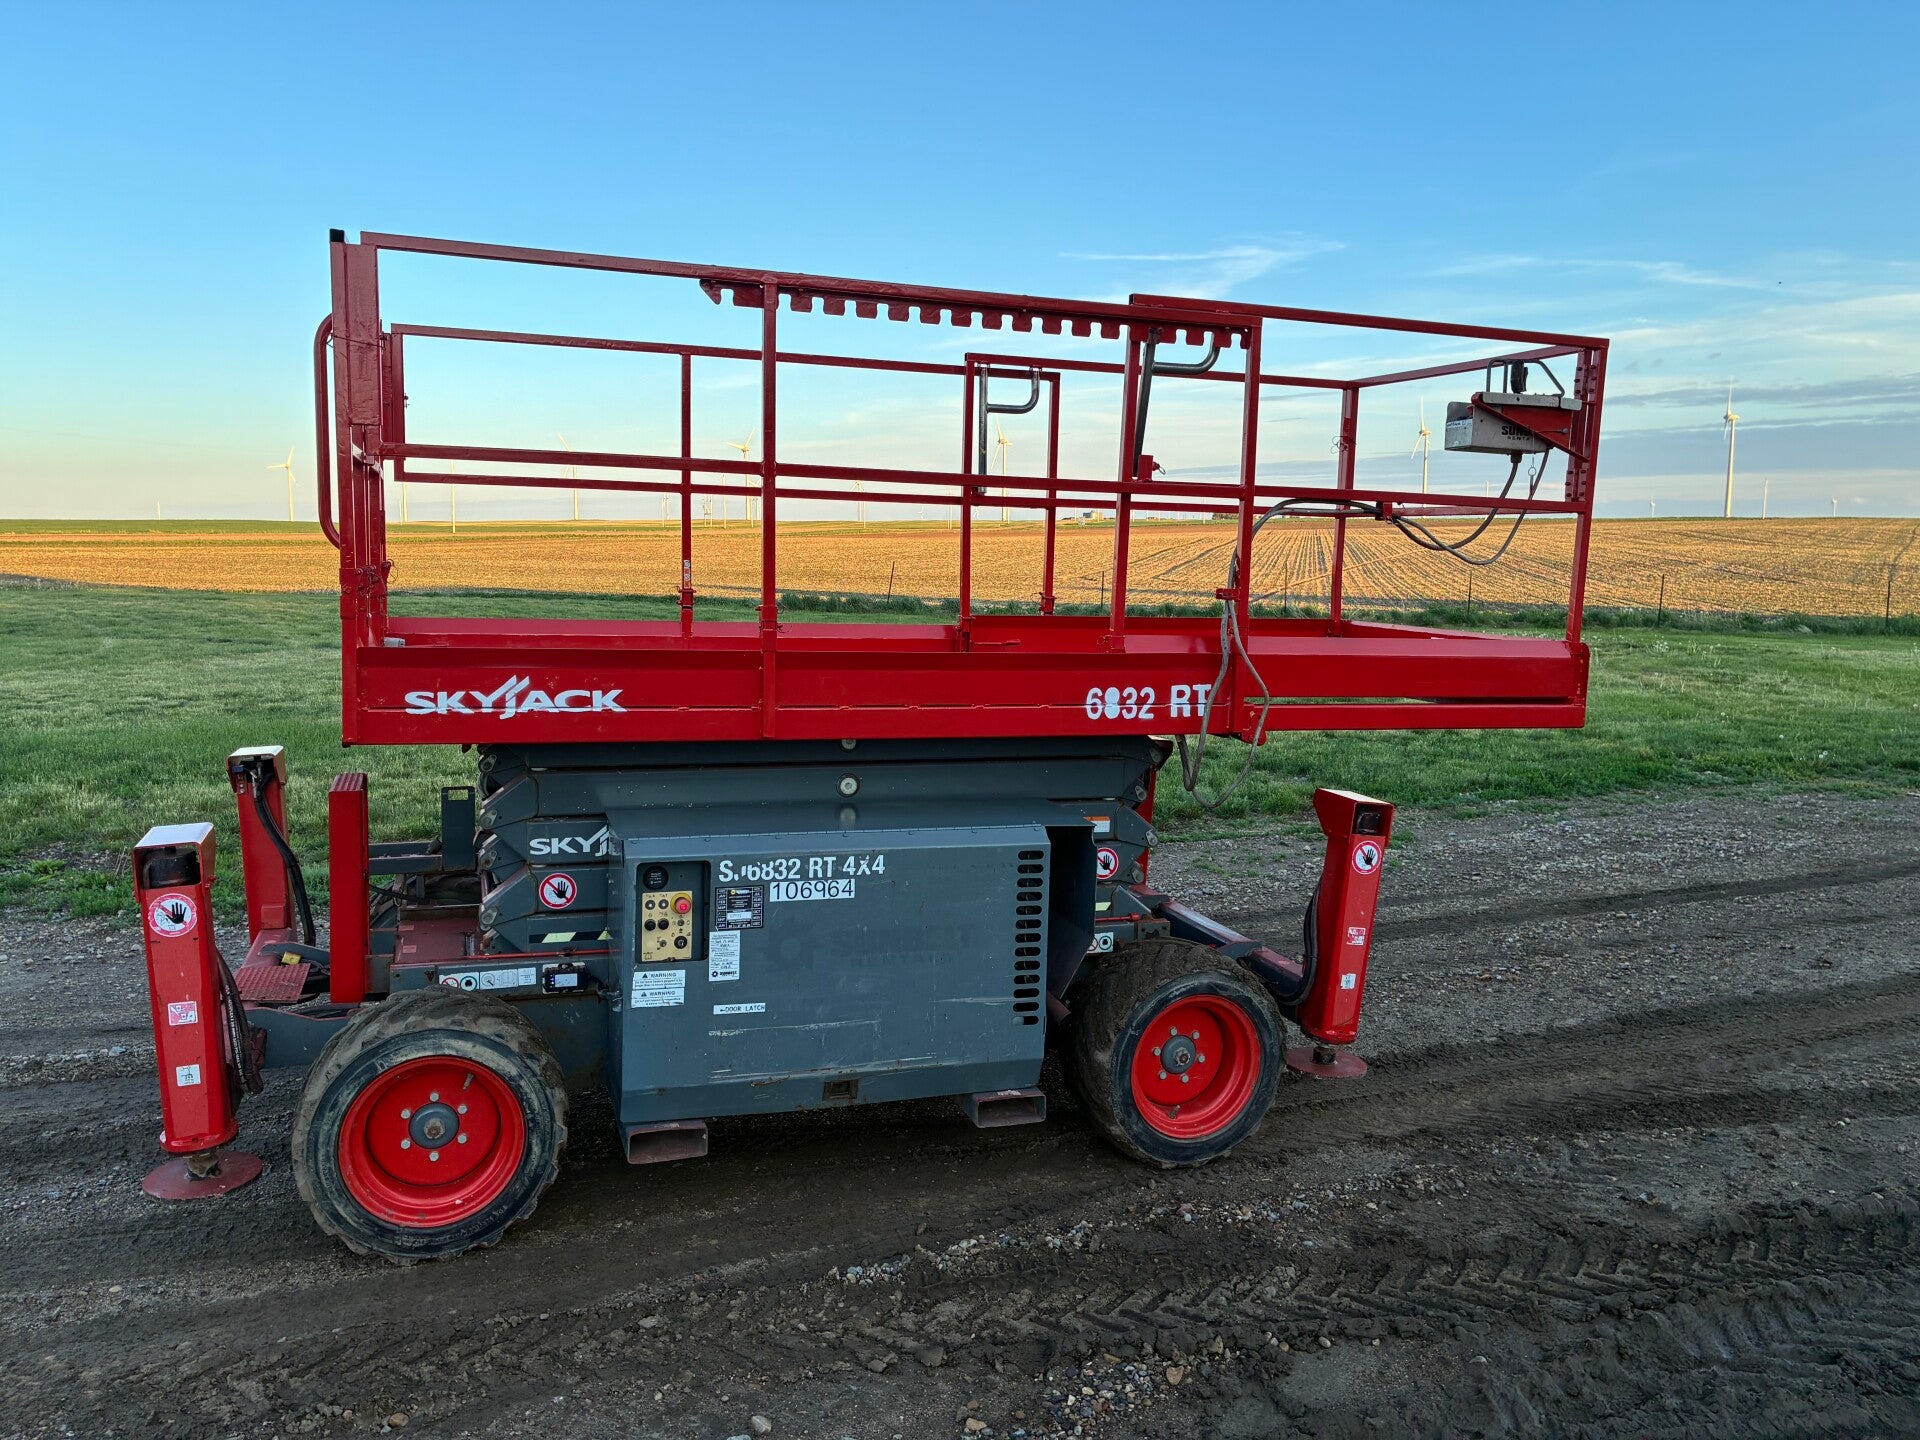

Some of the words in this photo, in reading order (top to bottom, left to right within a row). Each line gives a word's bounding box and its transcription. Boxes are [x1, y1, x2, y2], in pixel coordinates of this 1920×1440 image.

[1501, 425, 1533, 436] SUN
[404, 674, 628, 720] SKYJACK
[1170, 683, 1212, 717] RT
[808, 856, 837, 878] RT
[772, 880, 854, 900] 106964
[745, 1004, 765, 1012] LATCH
